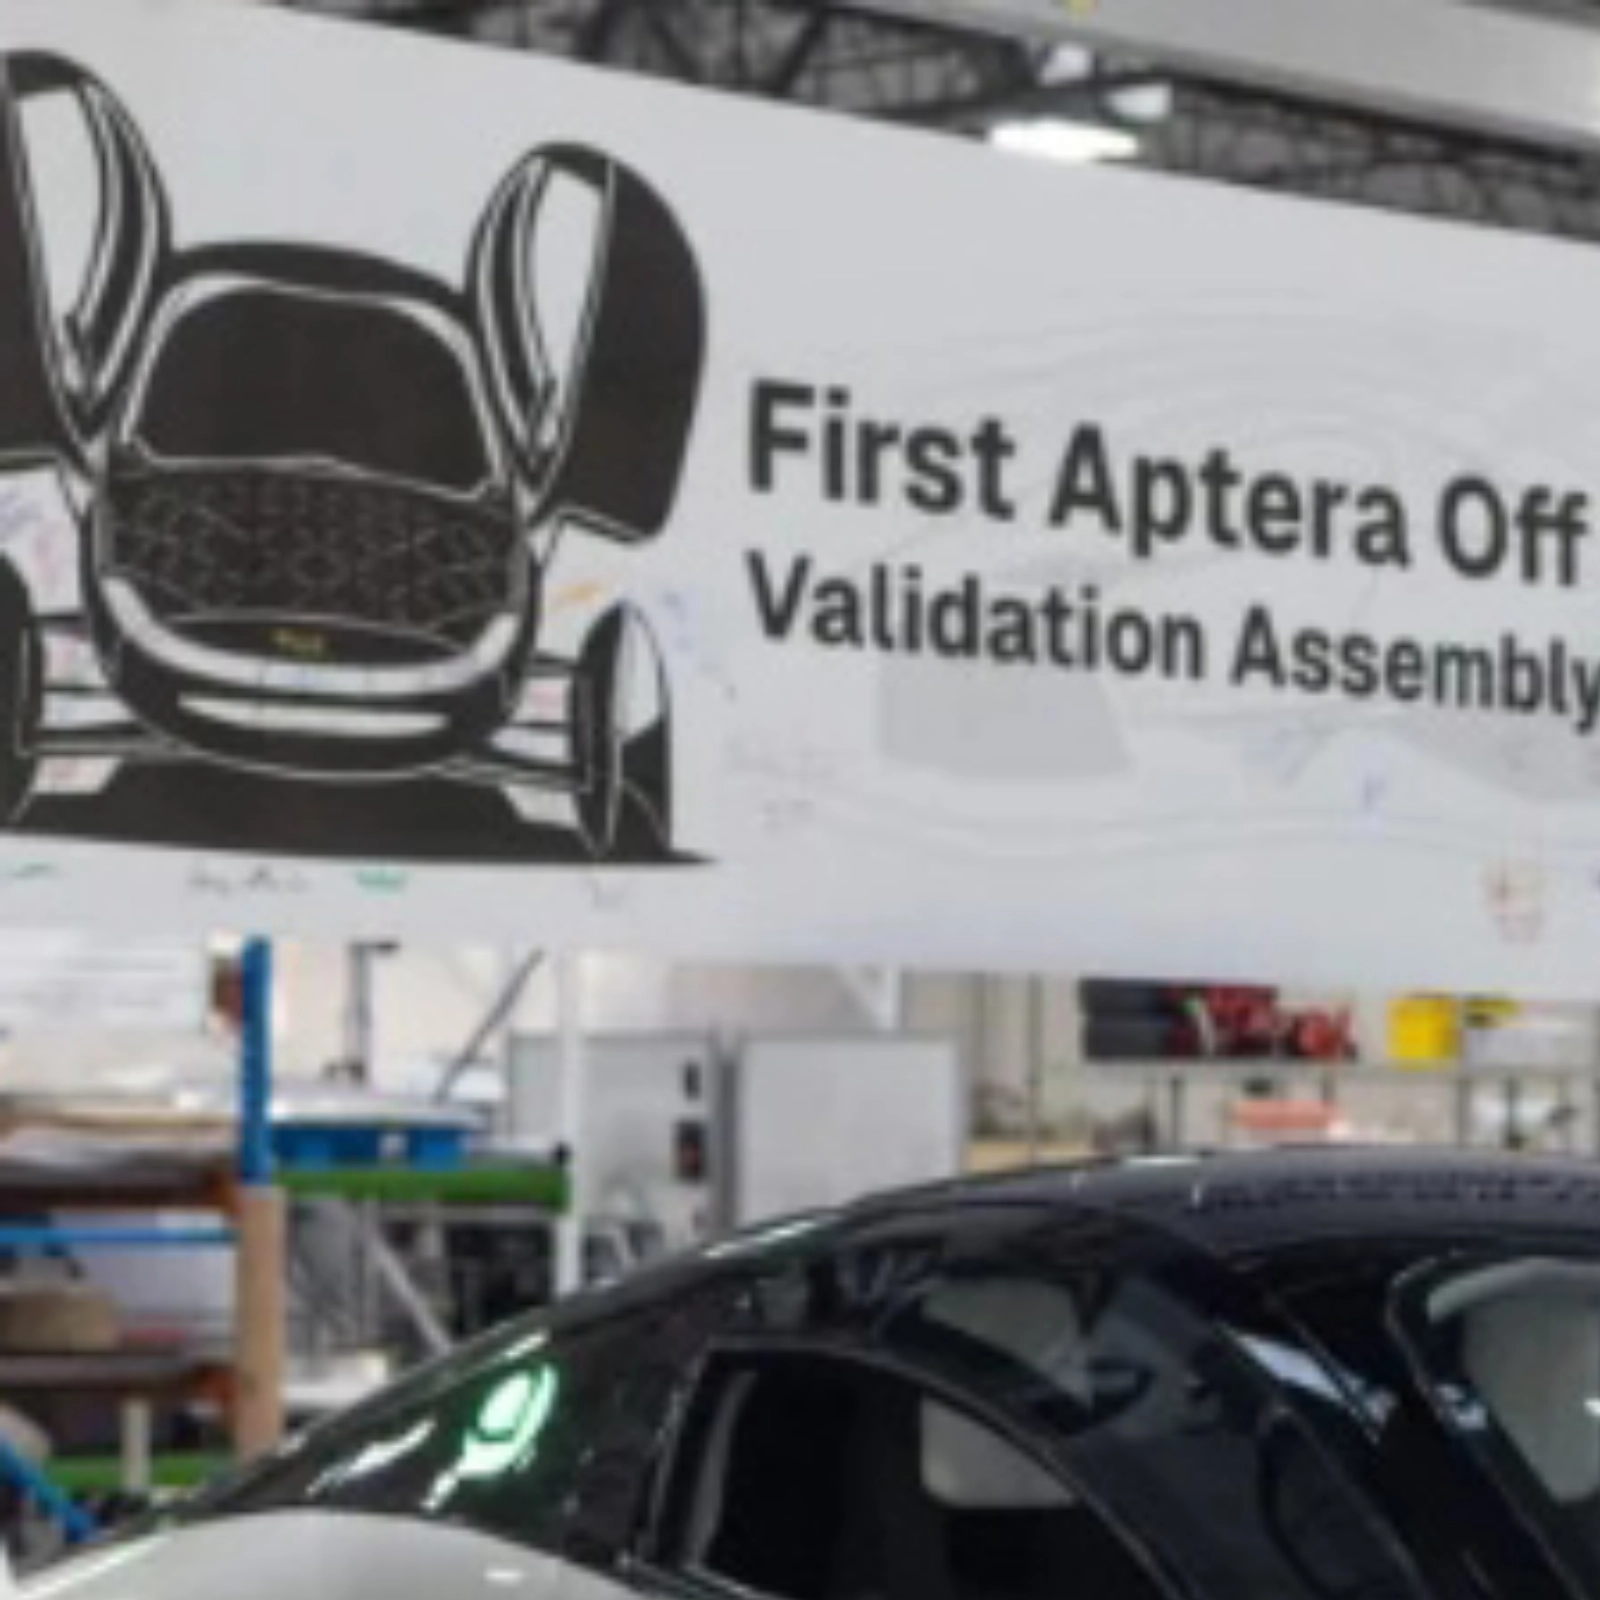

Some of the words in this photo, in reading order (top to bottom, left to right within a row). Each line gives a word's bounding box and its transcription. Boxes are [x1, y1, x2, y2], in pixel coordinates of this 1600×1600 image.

[748, 379, 1016, 522] First
[1048, 424, 1412, 569] Aptera
[1437, 475, 1588, 587] Off
[746, 550, 1204, 680] Validation
